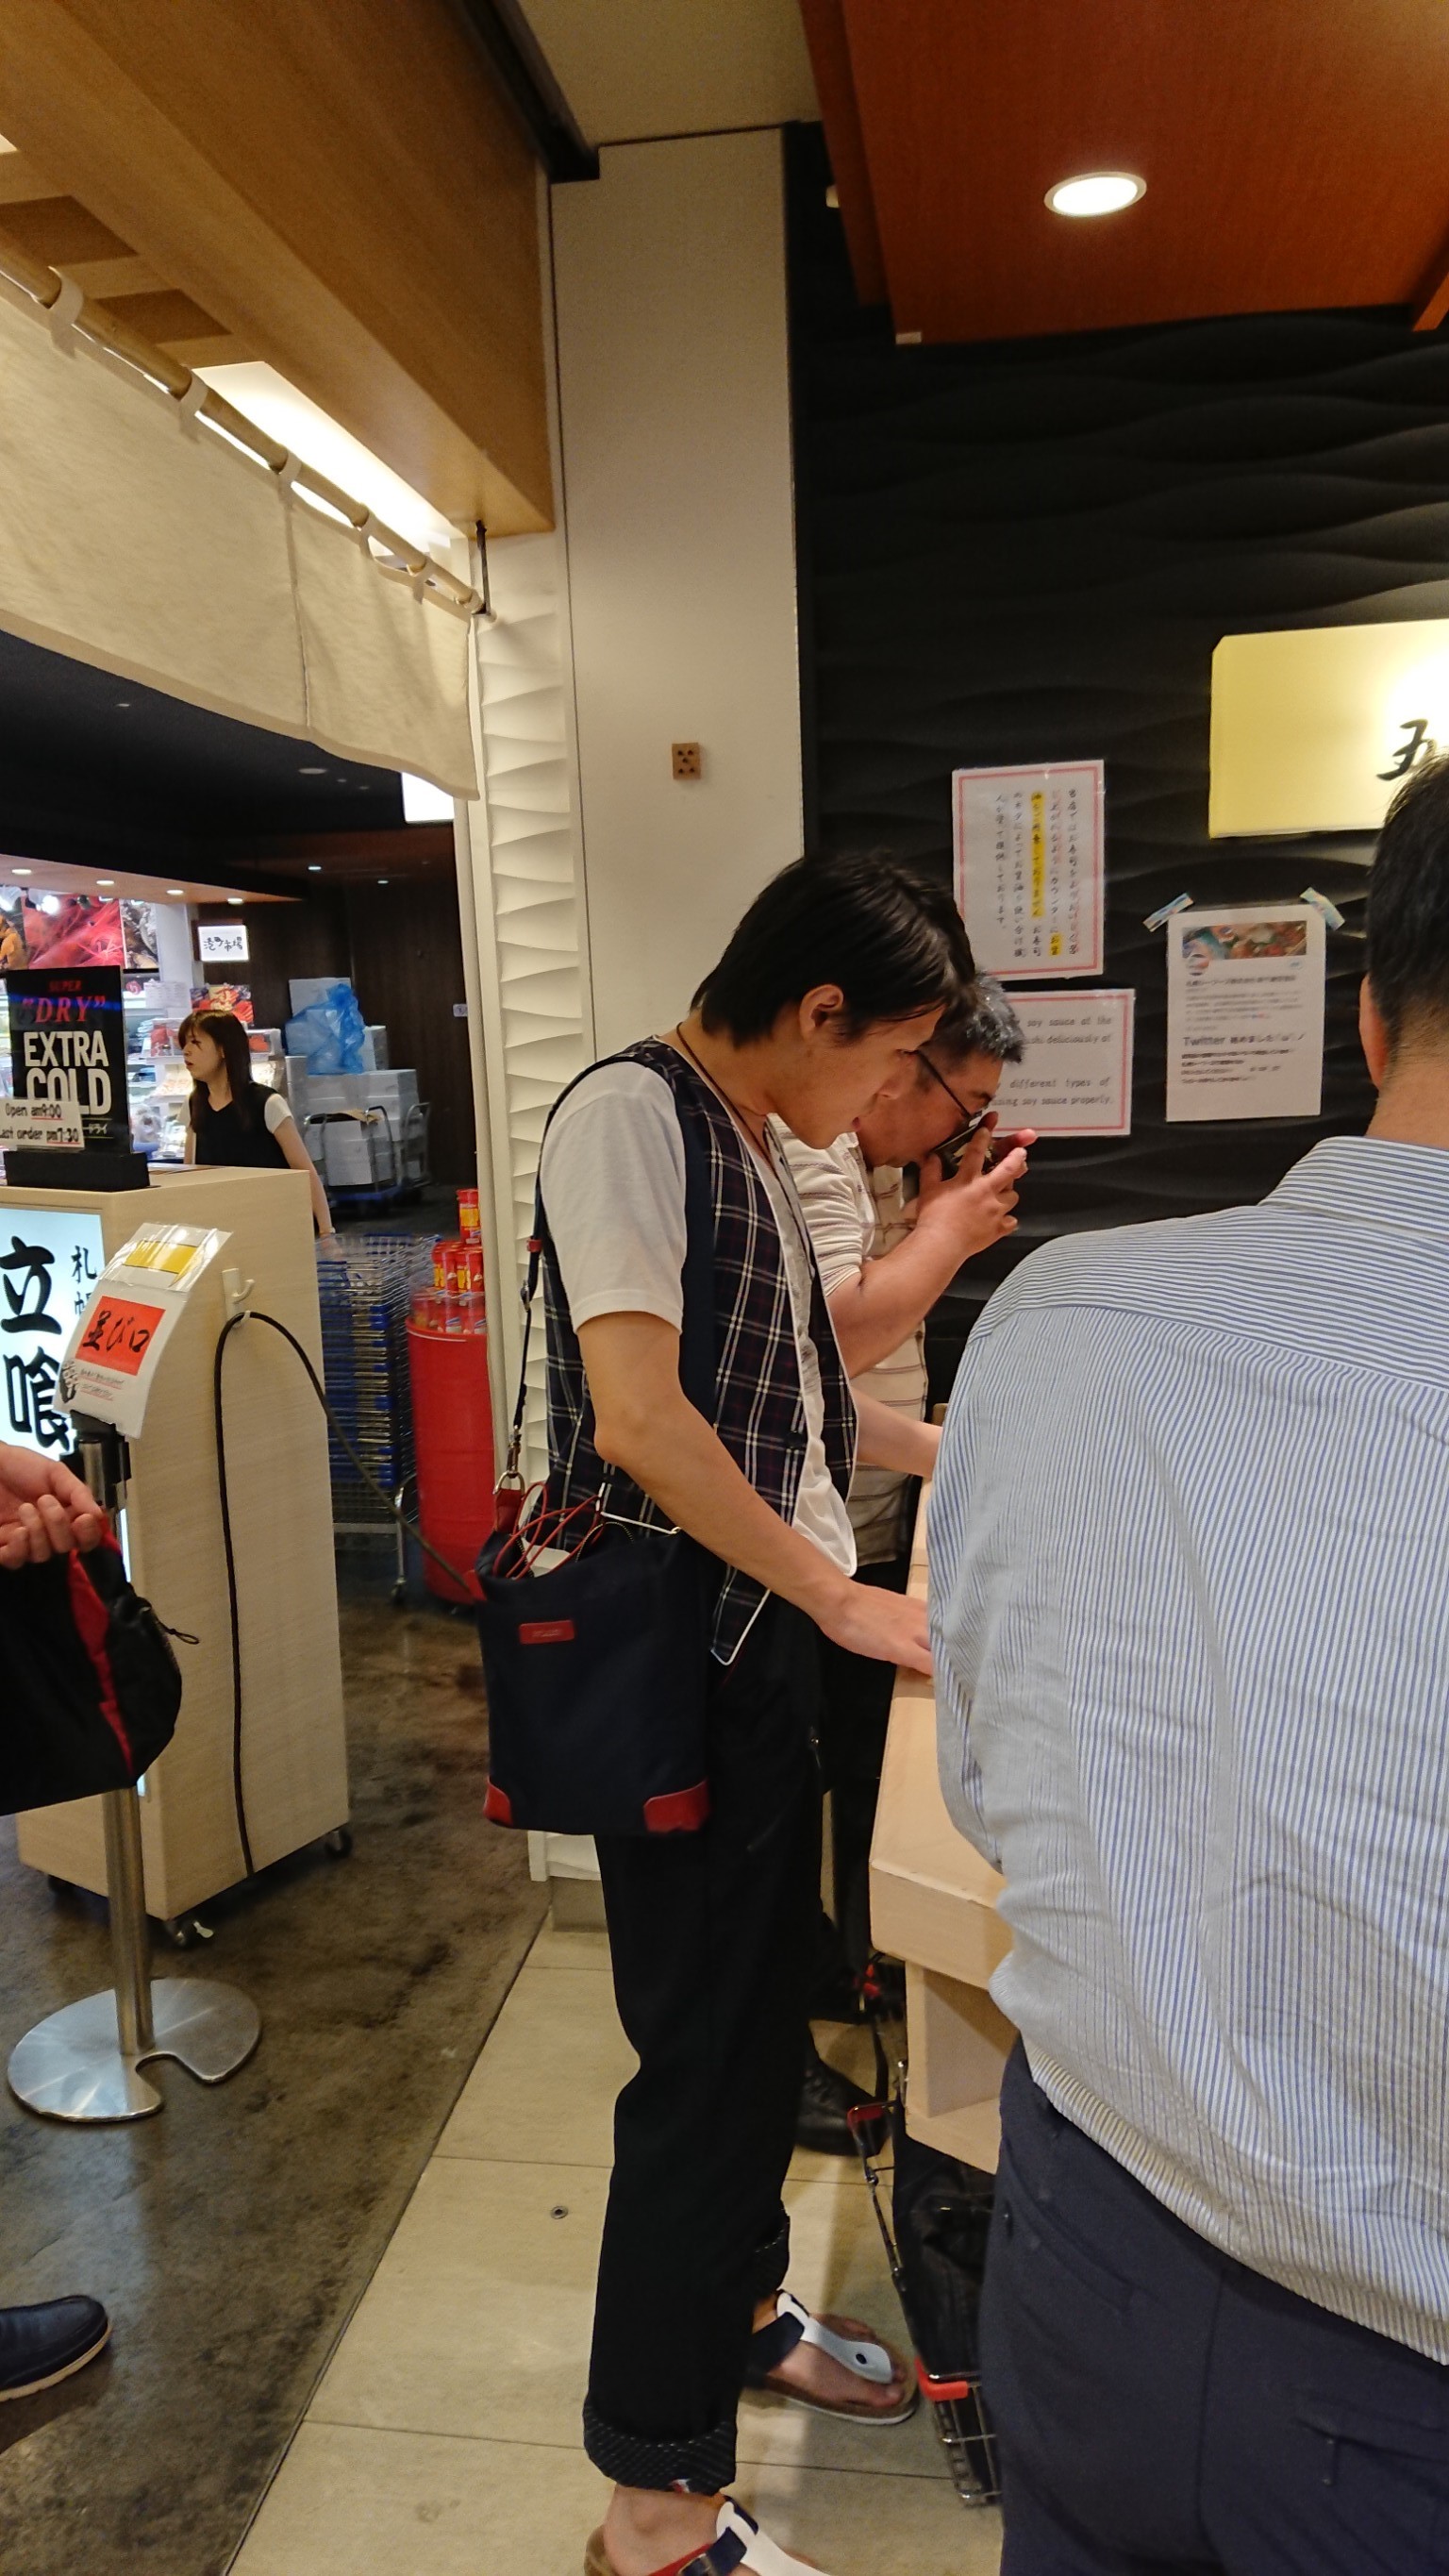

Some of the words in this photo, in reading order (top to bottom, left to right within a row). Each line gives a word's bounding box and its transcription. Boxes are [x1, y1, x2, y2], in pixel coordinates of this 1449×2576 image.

[1183, 1036, 1225, 1046] Twitter
[23, 1030, 109, 1067] EXTRA
[1009, 1079, 1057, 1089] different
[25, 1068, 112, 1115] COLD
[5, 1102, 28, 1118] Open
[17, 1127, 43, 1140] order
